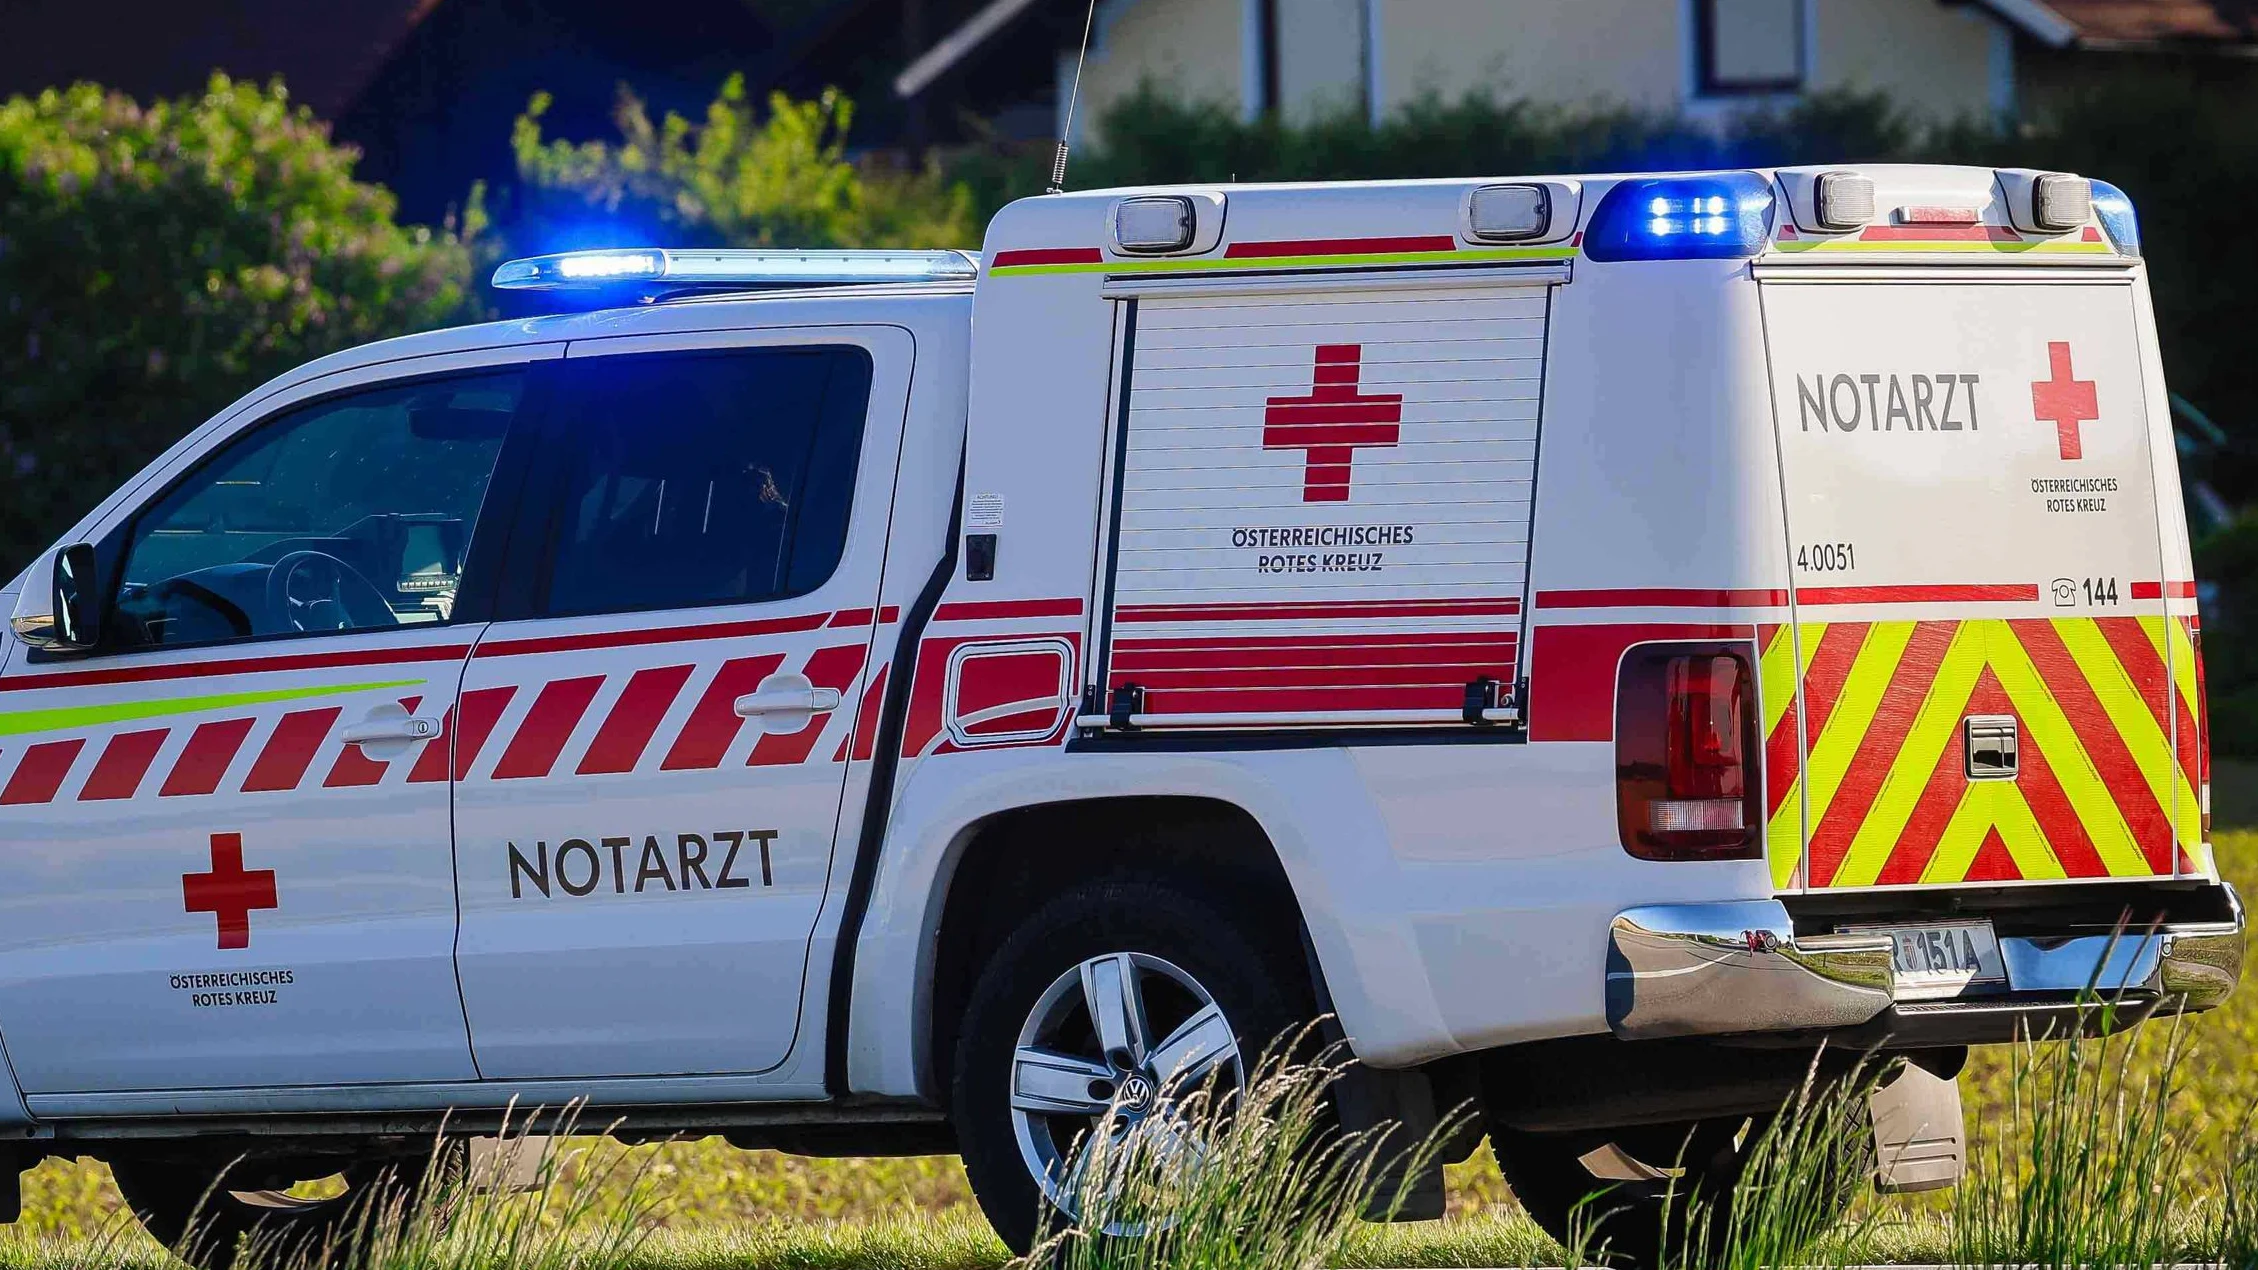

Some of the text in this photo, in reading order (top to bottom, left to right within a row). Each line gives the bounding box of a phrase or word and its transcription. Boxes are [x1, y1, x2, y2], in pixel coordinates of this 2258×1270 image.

[1796, 373, 1980, 432] NOTARZT
[2031, 478, 2117, 493] ÖSTERREICHISCHES
[2046, 498, 2106, 512] ROTES KREUZ
[1231, 525, 1414, 548] ÖSTERREICHISCHES
[1258, 552, 1384, 574] ROTES KREUZ
[1797, 543, 1856, 572] 4.0051
[2083, 577, 2118, 606] 144
[508, 829, 778, 899] NOTARZT
[1916, 929, 1982, 976] 151A
[169, 970, 295, 989] ÖSTERREICHISCHES
[192, 990, 278, 1007] ROTES KREUZ
